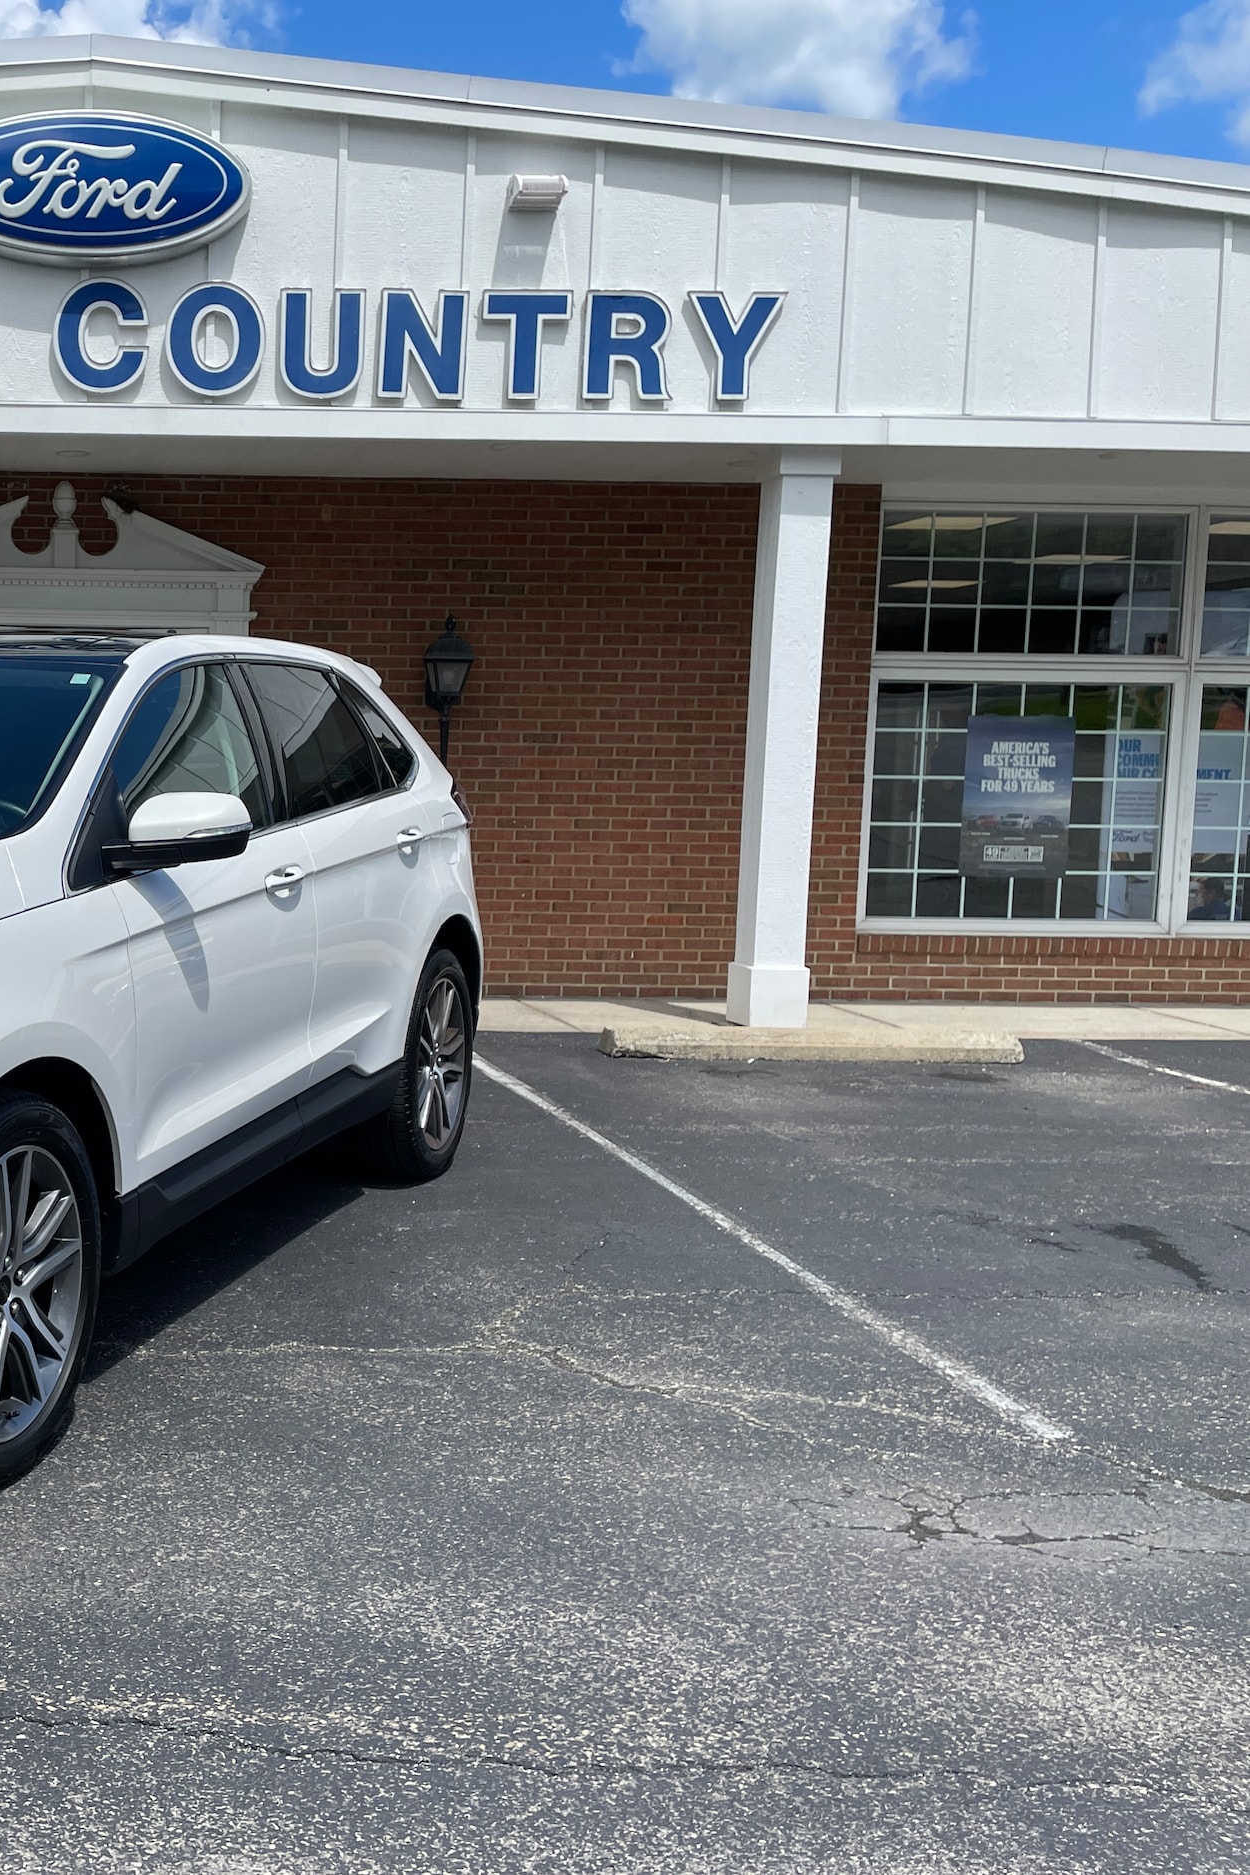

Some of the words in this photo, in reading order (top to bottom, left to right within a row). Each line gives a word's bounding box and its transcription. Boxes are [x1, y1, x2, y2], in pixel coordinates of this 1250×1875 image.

[53, 277, 785, 401] COUNTRY
[991, 741, 1049, 754] AMERICA'S
[982, 754, 1056, 768] BEST-SELLING
[998, 767, 1039, 779] TRUCKS
[981, 779, 1002, 792] FOR
[1021, 780, 1055, 793] YEARS
